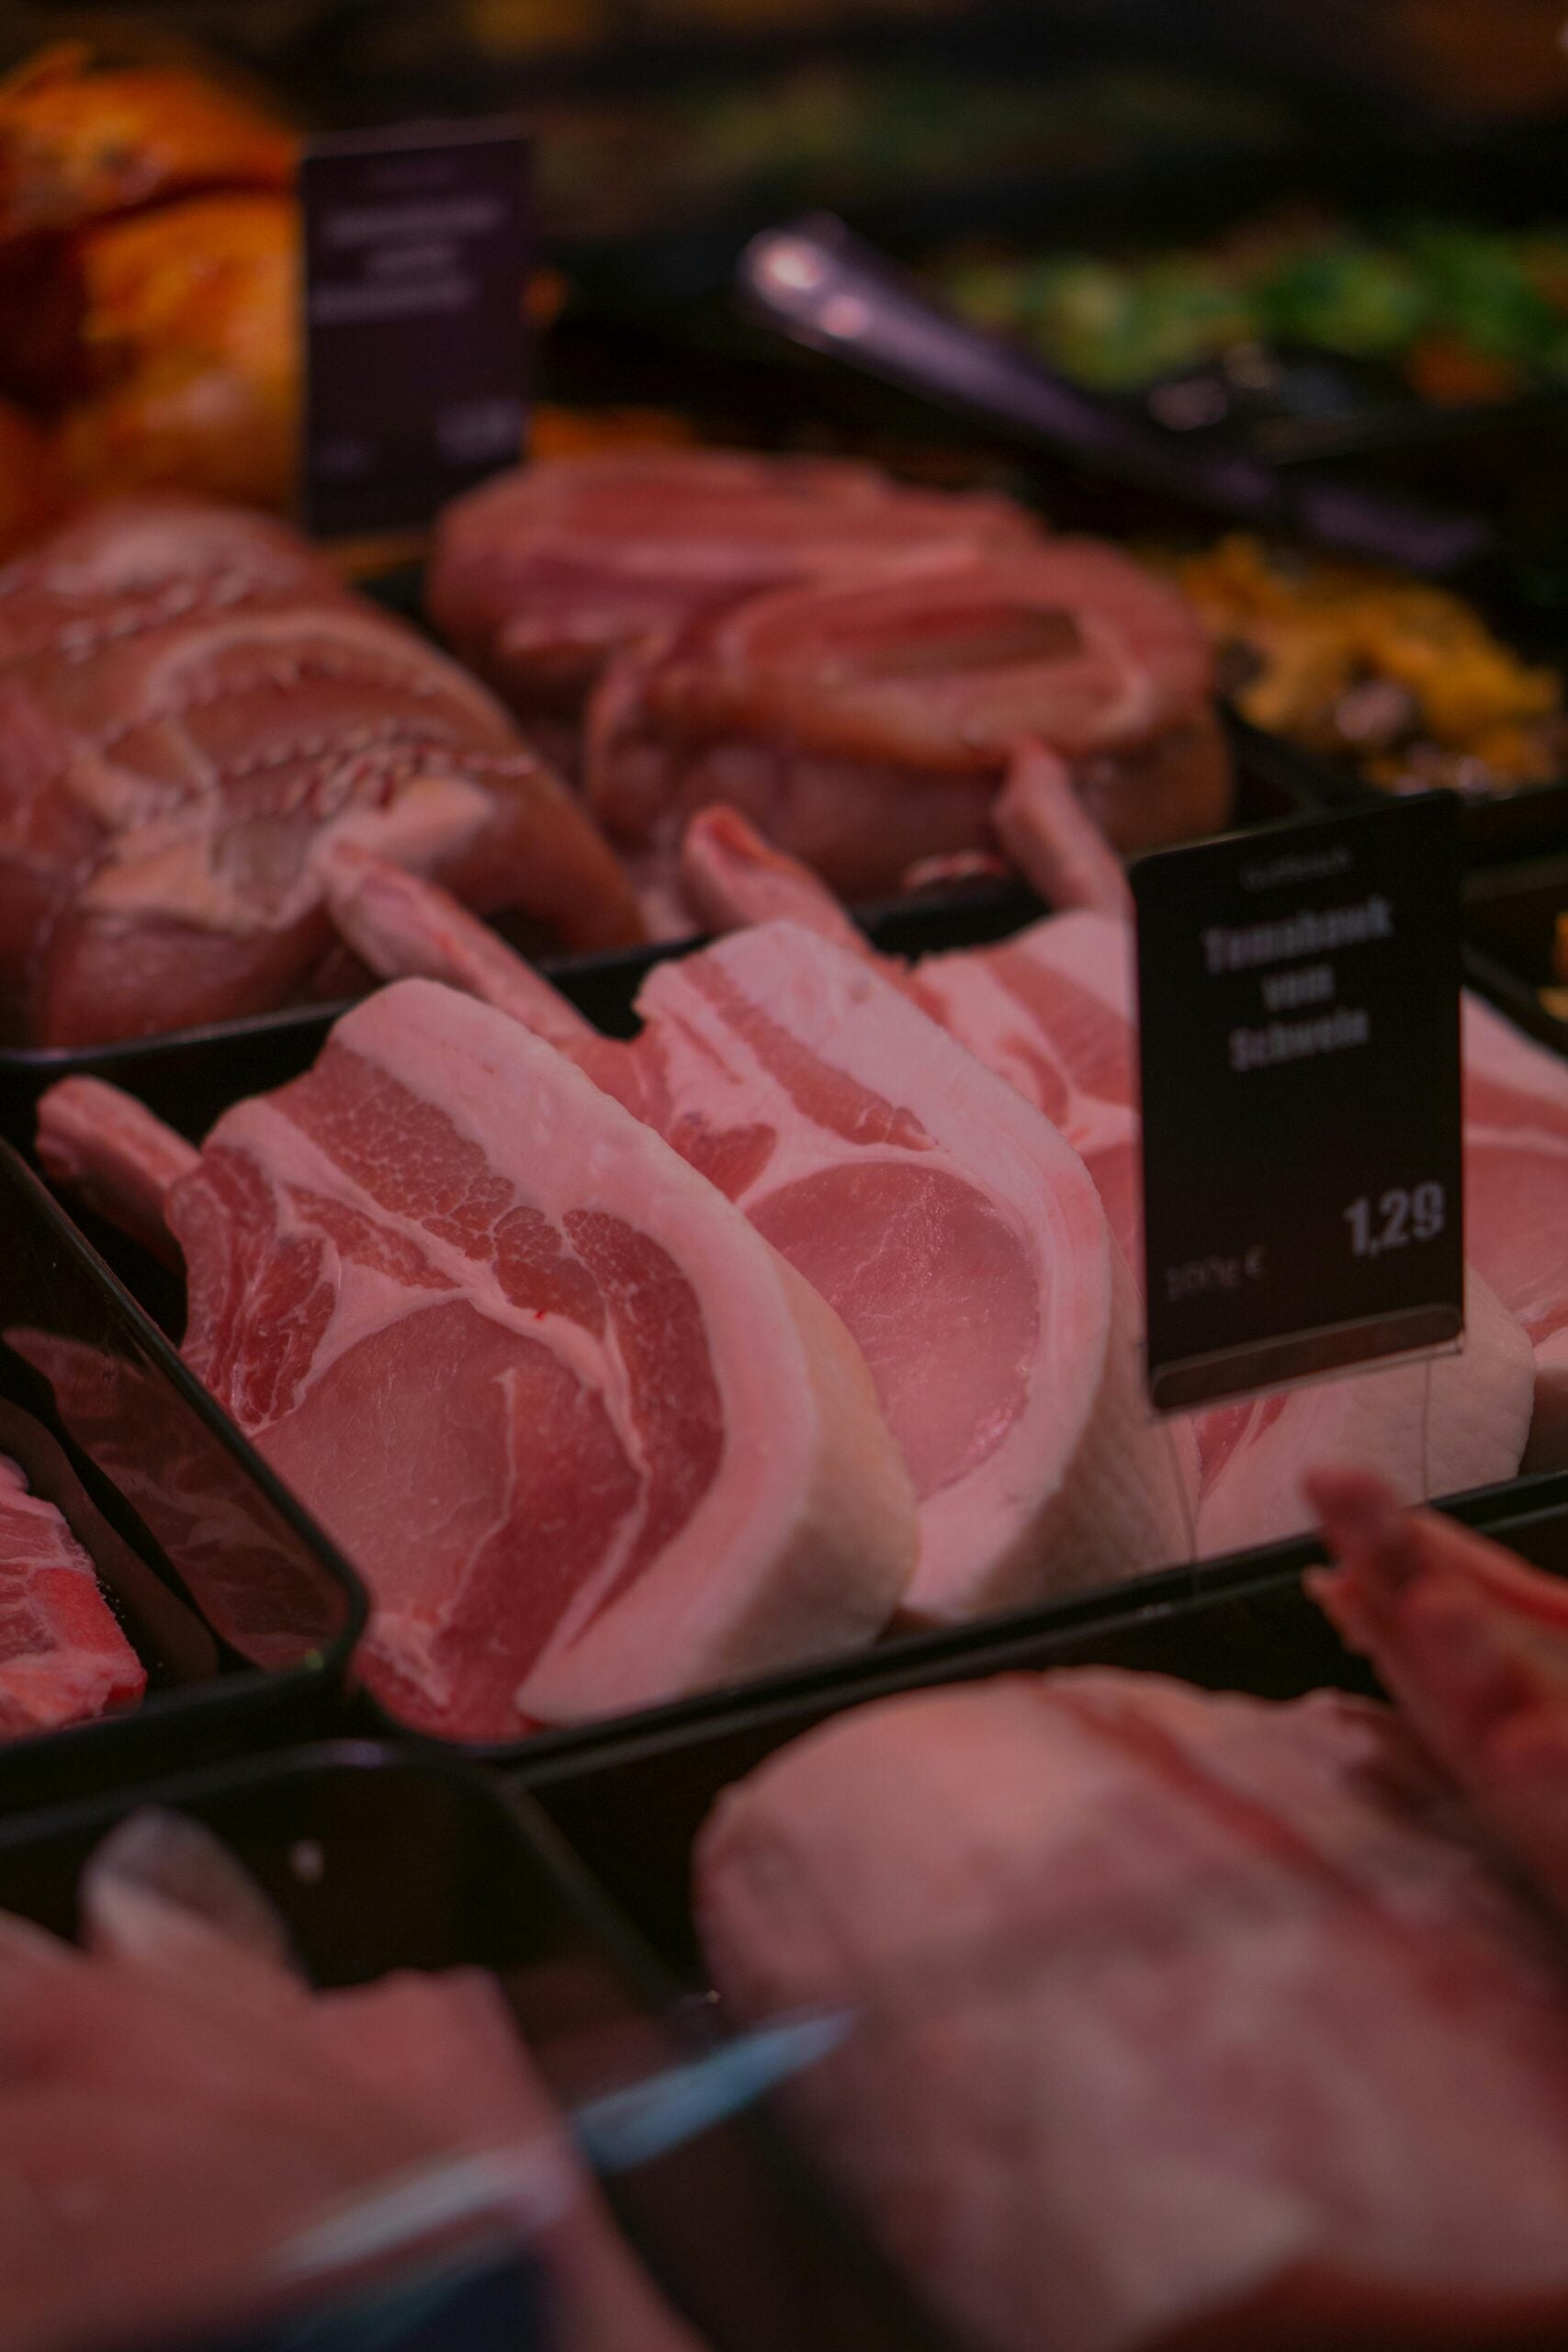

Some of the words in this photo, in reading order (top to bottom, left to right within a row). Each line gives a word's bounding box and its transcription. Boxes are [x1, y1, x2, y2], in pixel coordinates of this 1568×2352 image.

[1203, 897, 1393, 972] Tomahawk
[1230, 1007, 1369, 1070] Schwein
[1345, 1182, 1444, 1260] 1,29
